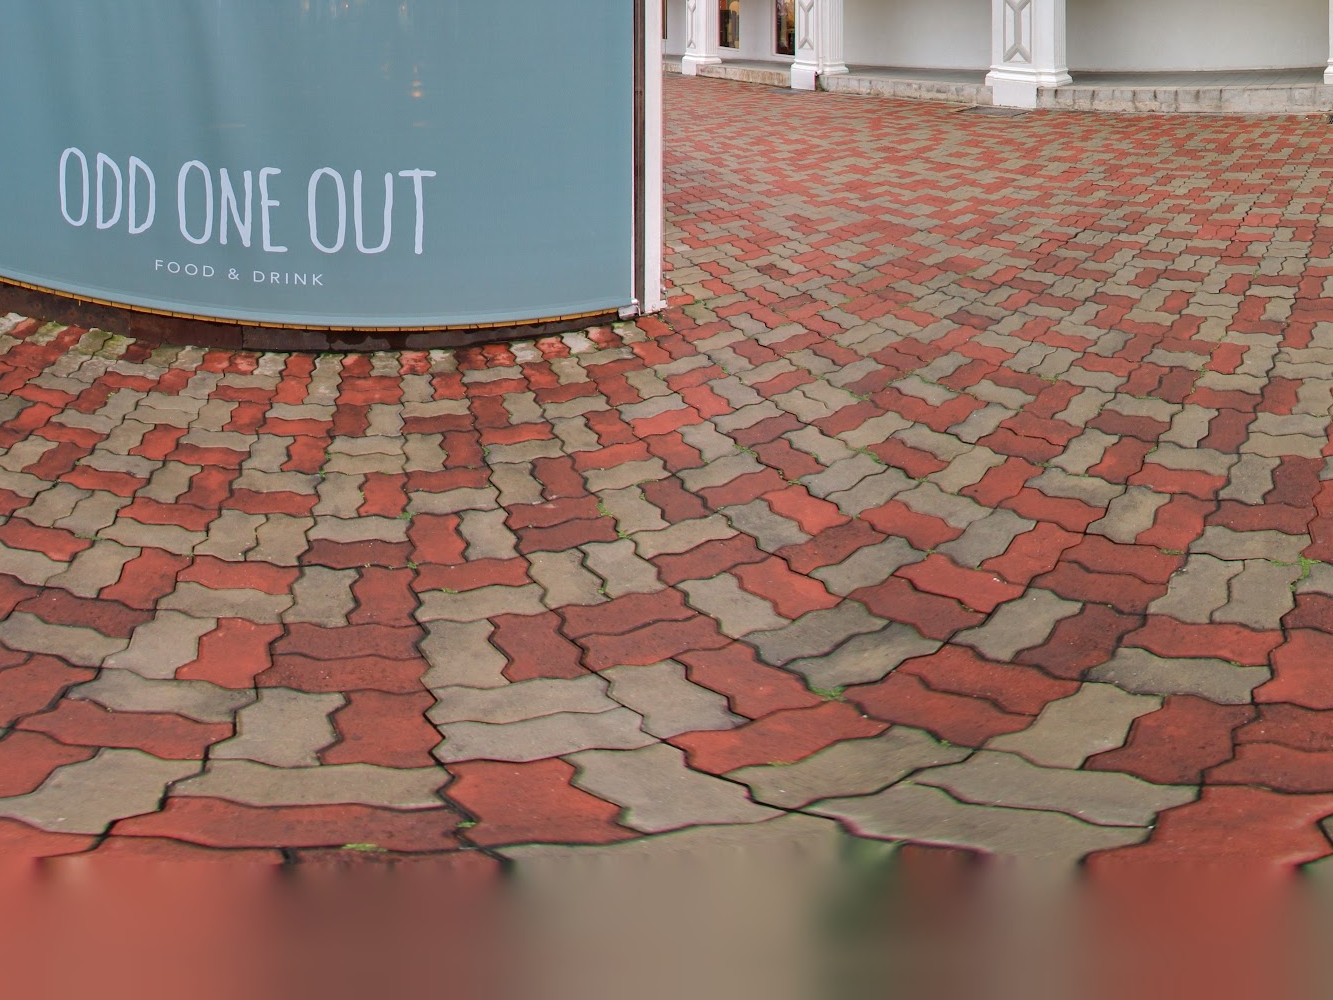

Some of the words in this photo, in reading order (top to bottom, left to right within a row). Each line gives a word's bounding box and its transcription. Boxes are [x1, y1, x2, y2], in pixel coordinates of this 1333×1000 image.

[59, 147, 156, 235] ODD
[177, 159, 288, 253] ONE
[307, 166, 437, 255] OUT
[155, 259, 216, 278] FOOD
[227, 267, 240, 281] &
[252, 270, 324, 286] DRINK
